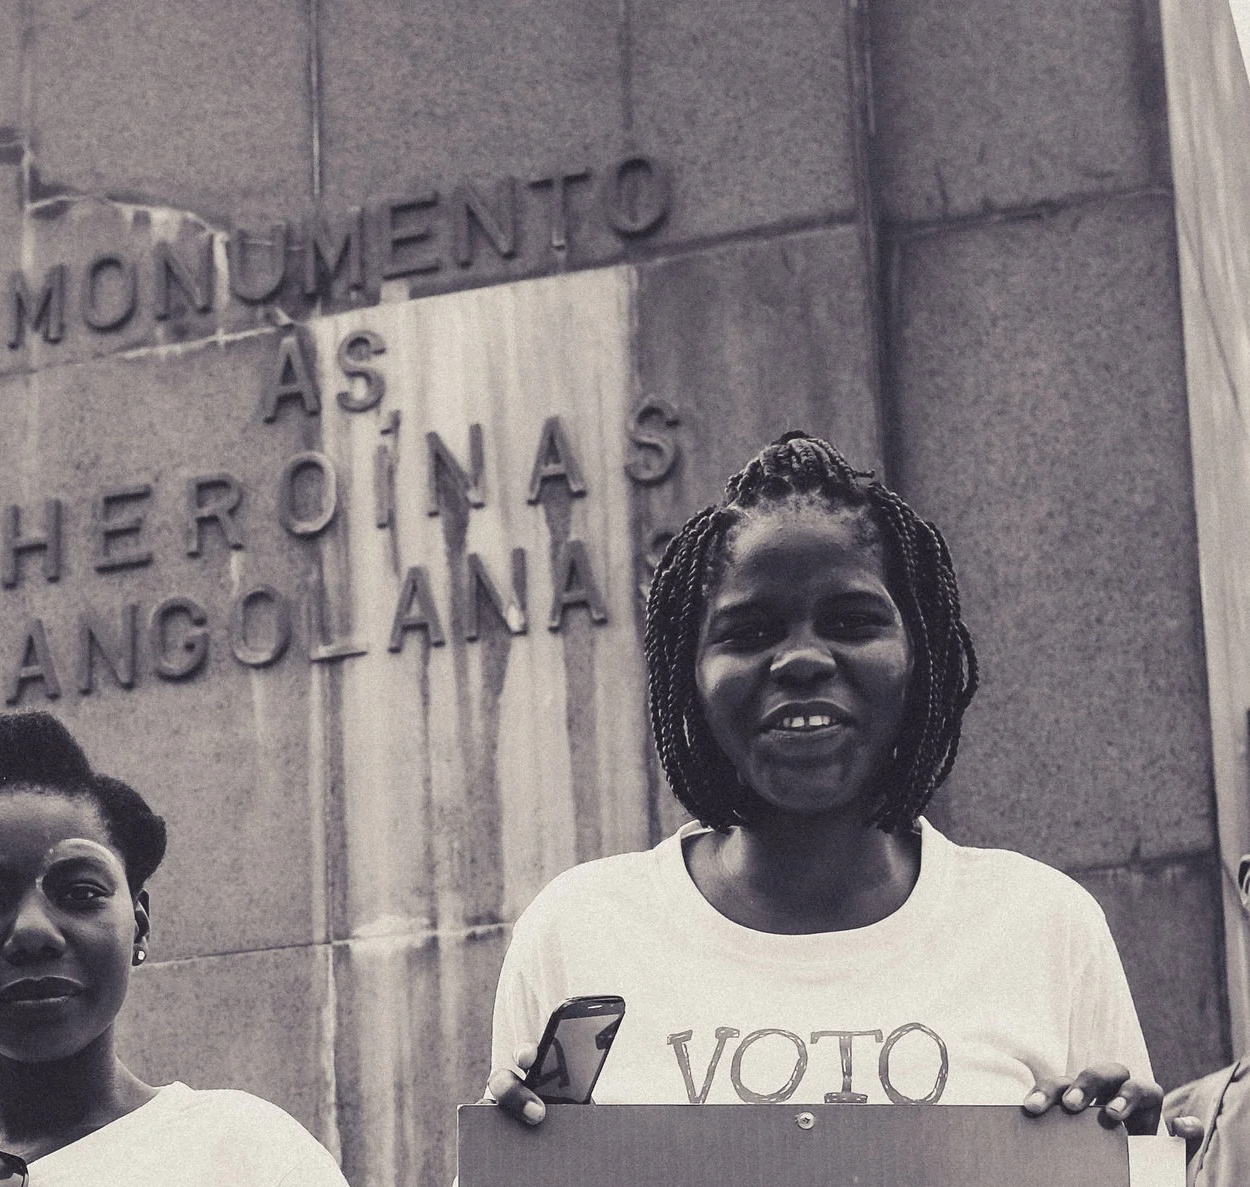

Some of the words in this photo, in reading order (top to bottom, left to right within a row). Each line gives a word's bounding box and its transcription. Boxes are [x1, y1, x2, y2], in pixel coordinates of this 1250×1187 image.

[6, 156, 674, 350] MONUMENTO
[0, 400, 683, 590] HEROÍNAS
[665, 1022, 950, 1105] VOTO
